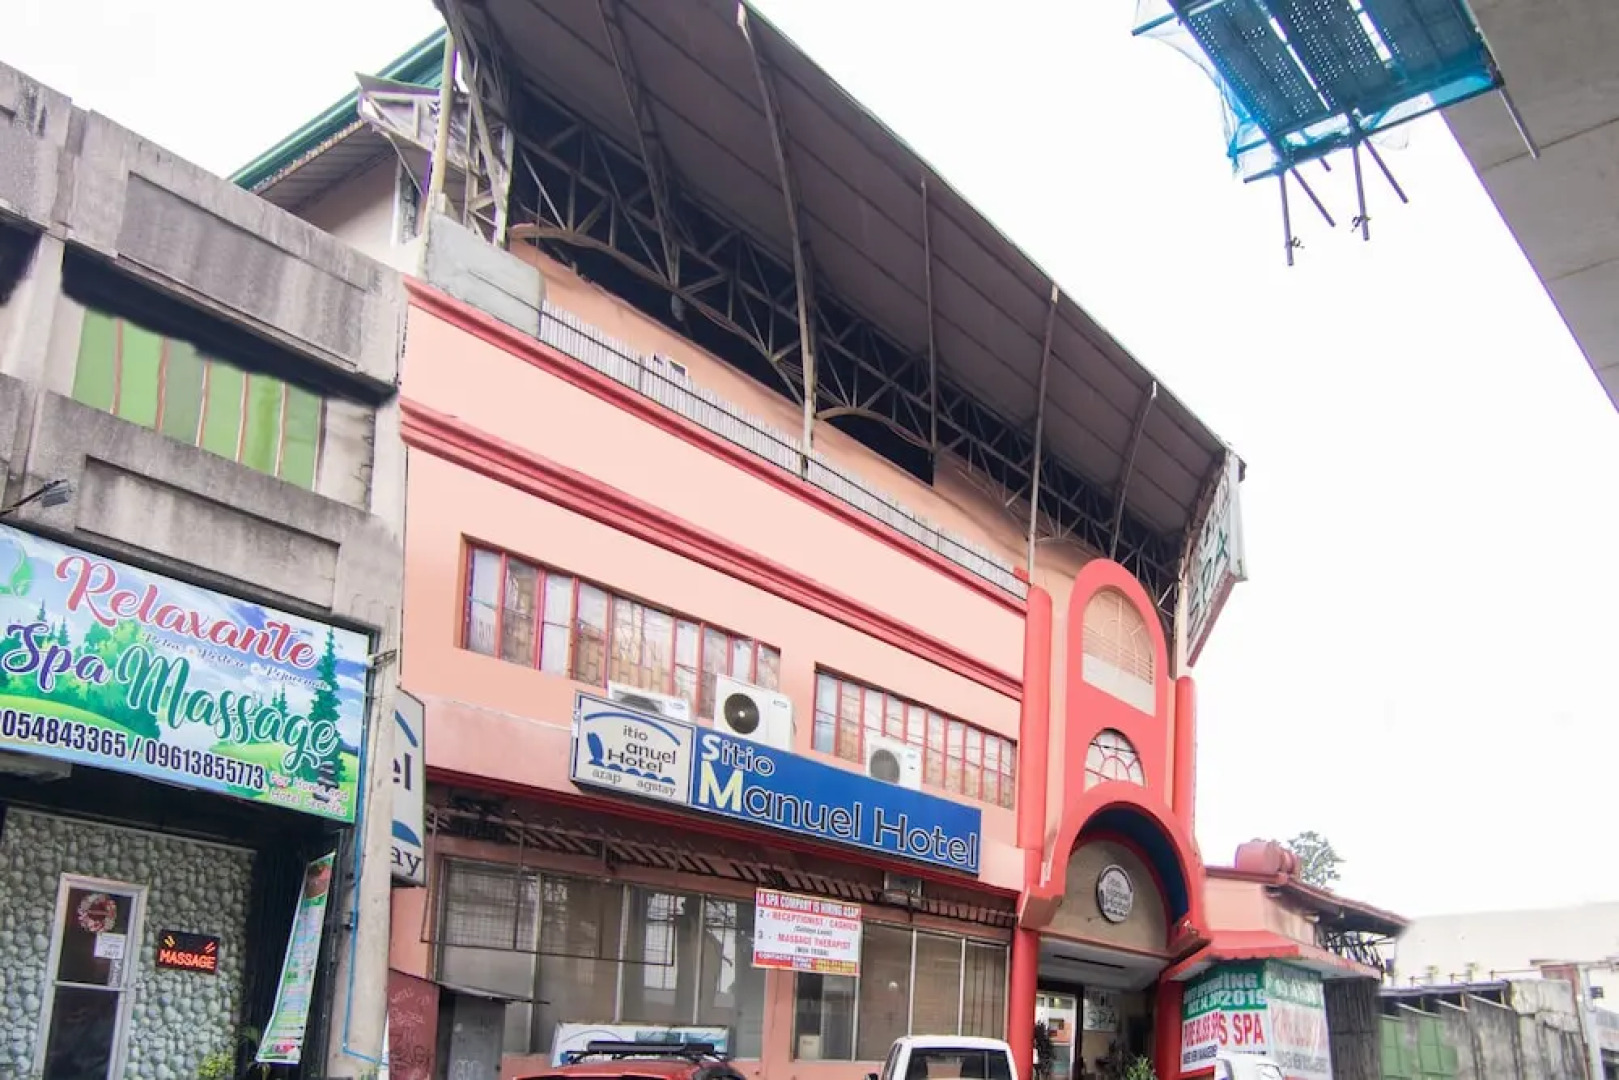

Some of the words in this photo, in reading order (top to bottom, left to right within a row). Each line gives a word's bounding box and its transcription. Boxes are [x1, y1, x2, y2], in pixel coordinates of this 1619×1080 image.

[55, 555, 318, 669] Relaxante
[3, 622, 110, 691] Spa
[116, 645, 339, 773] Massage
[623, 725, 648, 741] itio
[0, 710, 126, 759] 054843365
[131, 738, 141, 761] /
[145, 738, 265, 789] 09613855773
[607, 747, 663, 773] Hotel
[625, 742, 676, 765] anuel
[701, 734, 775, 776] Sitio
[698, 760, 863, 839] Manuel
[873, 806, 977, 867] Hotel
[759, 909, 765, 918] 2
[771, 911, 823, 926] RECEPTIONIST
[777, 934, 812, 946] MASSAGE
[814, 938, 851, 950] THERAPIST
[159, 949, 217, 969] MASSAGE
[1232, 1012, 1266, 1046] SPA
